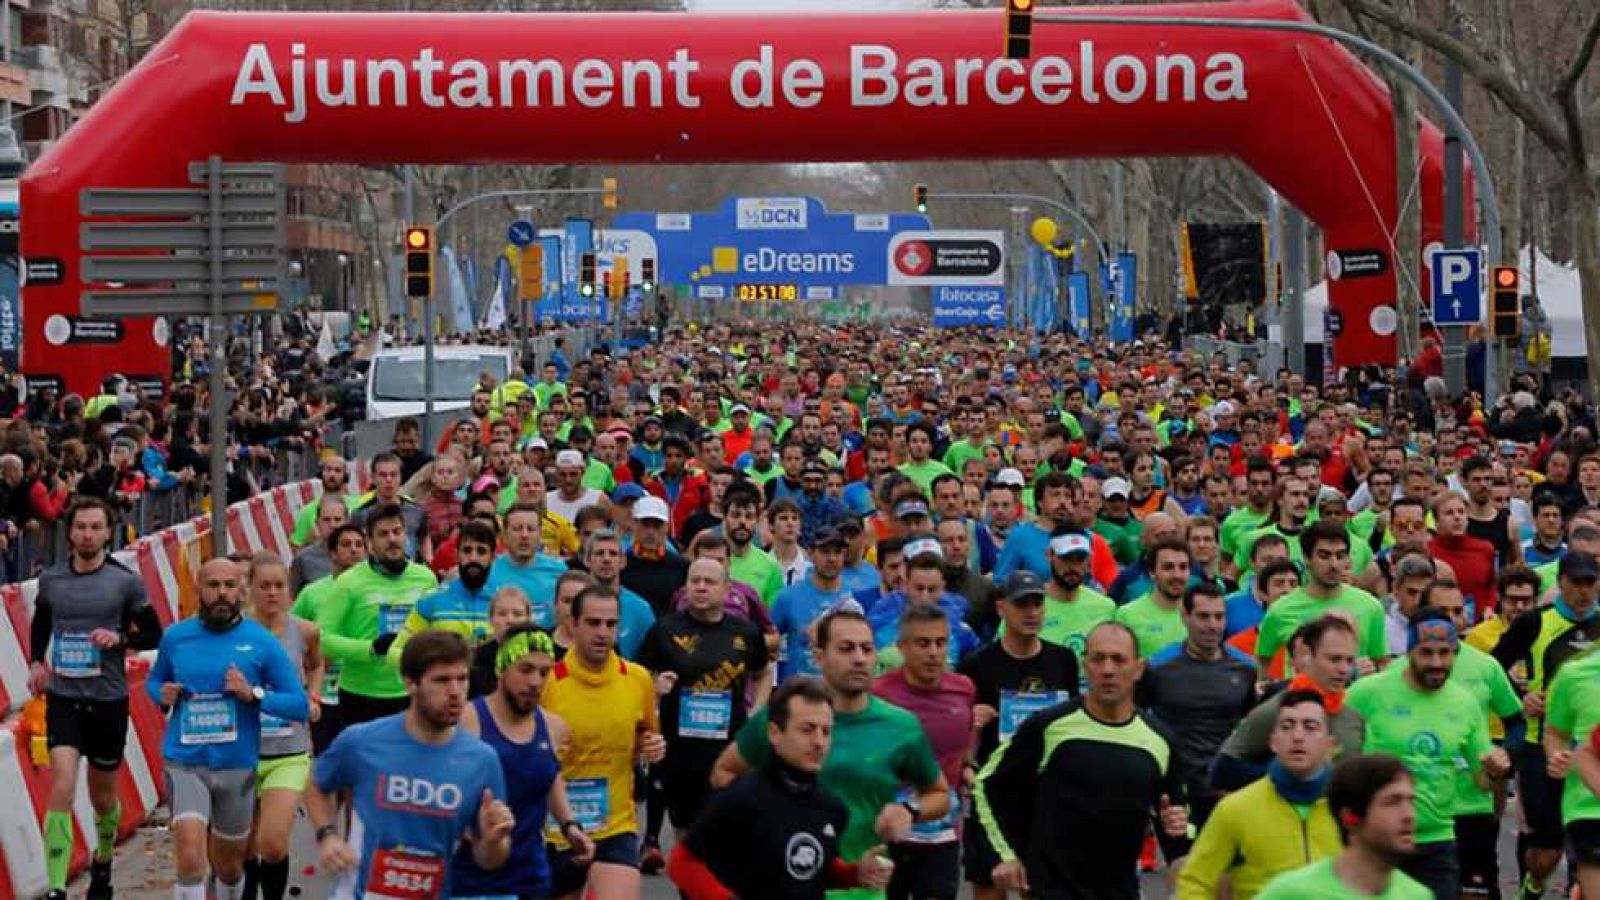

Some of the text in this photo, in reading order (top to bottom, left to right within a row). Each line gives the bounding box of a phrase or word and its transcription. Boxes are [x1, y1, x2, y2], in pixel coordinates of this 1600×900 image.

[231, 40, 1248, 122] Ajuntament de Barcelona
[743, 246, 855, 272] eDreams
[937, 257, 989, 267] Barcelona
[1441, 255, 1471, 296] P
[941, 287, 1000, 302] fotocasa
[386, 774, 463, 810] BDO
